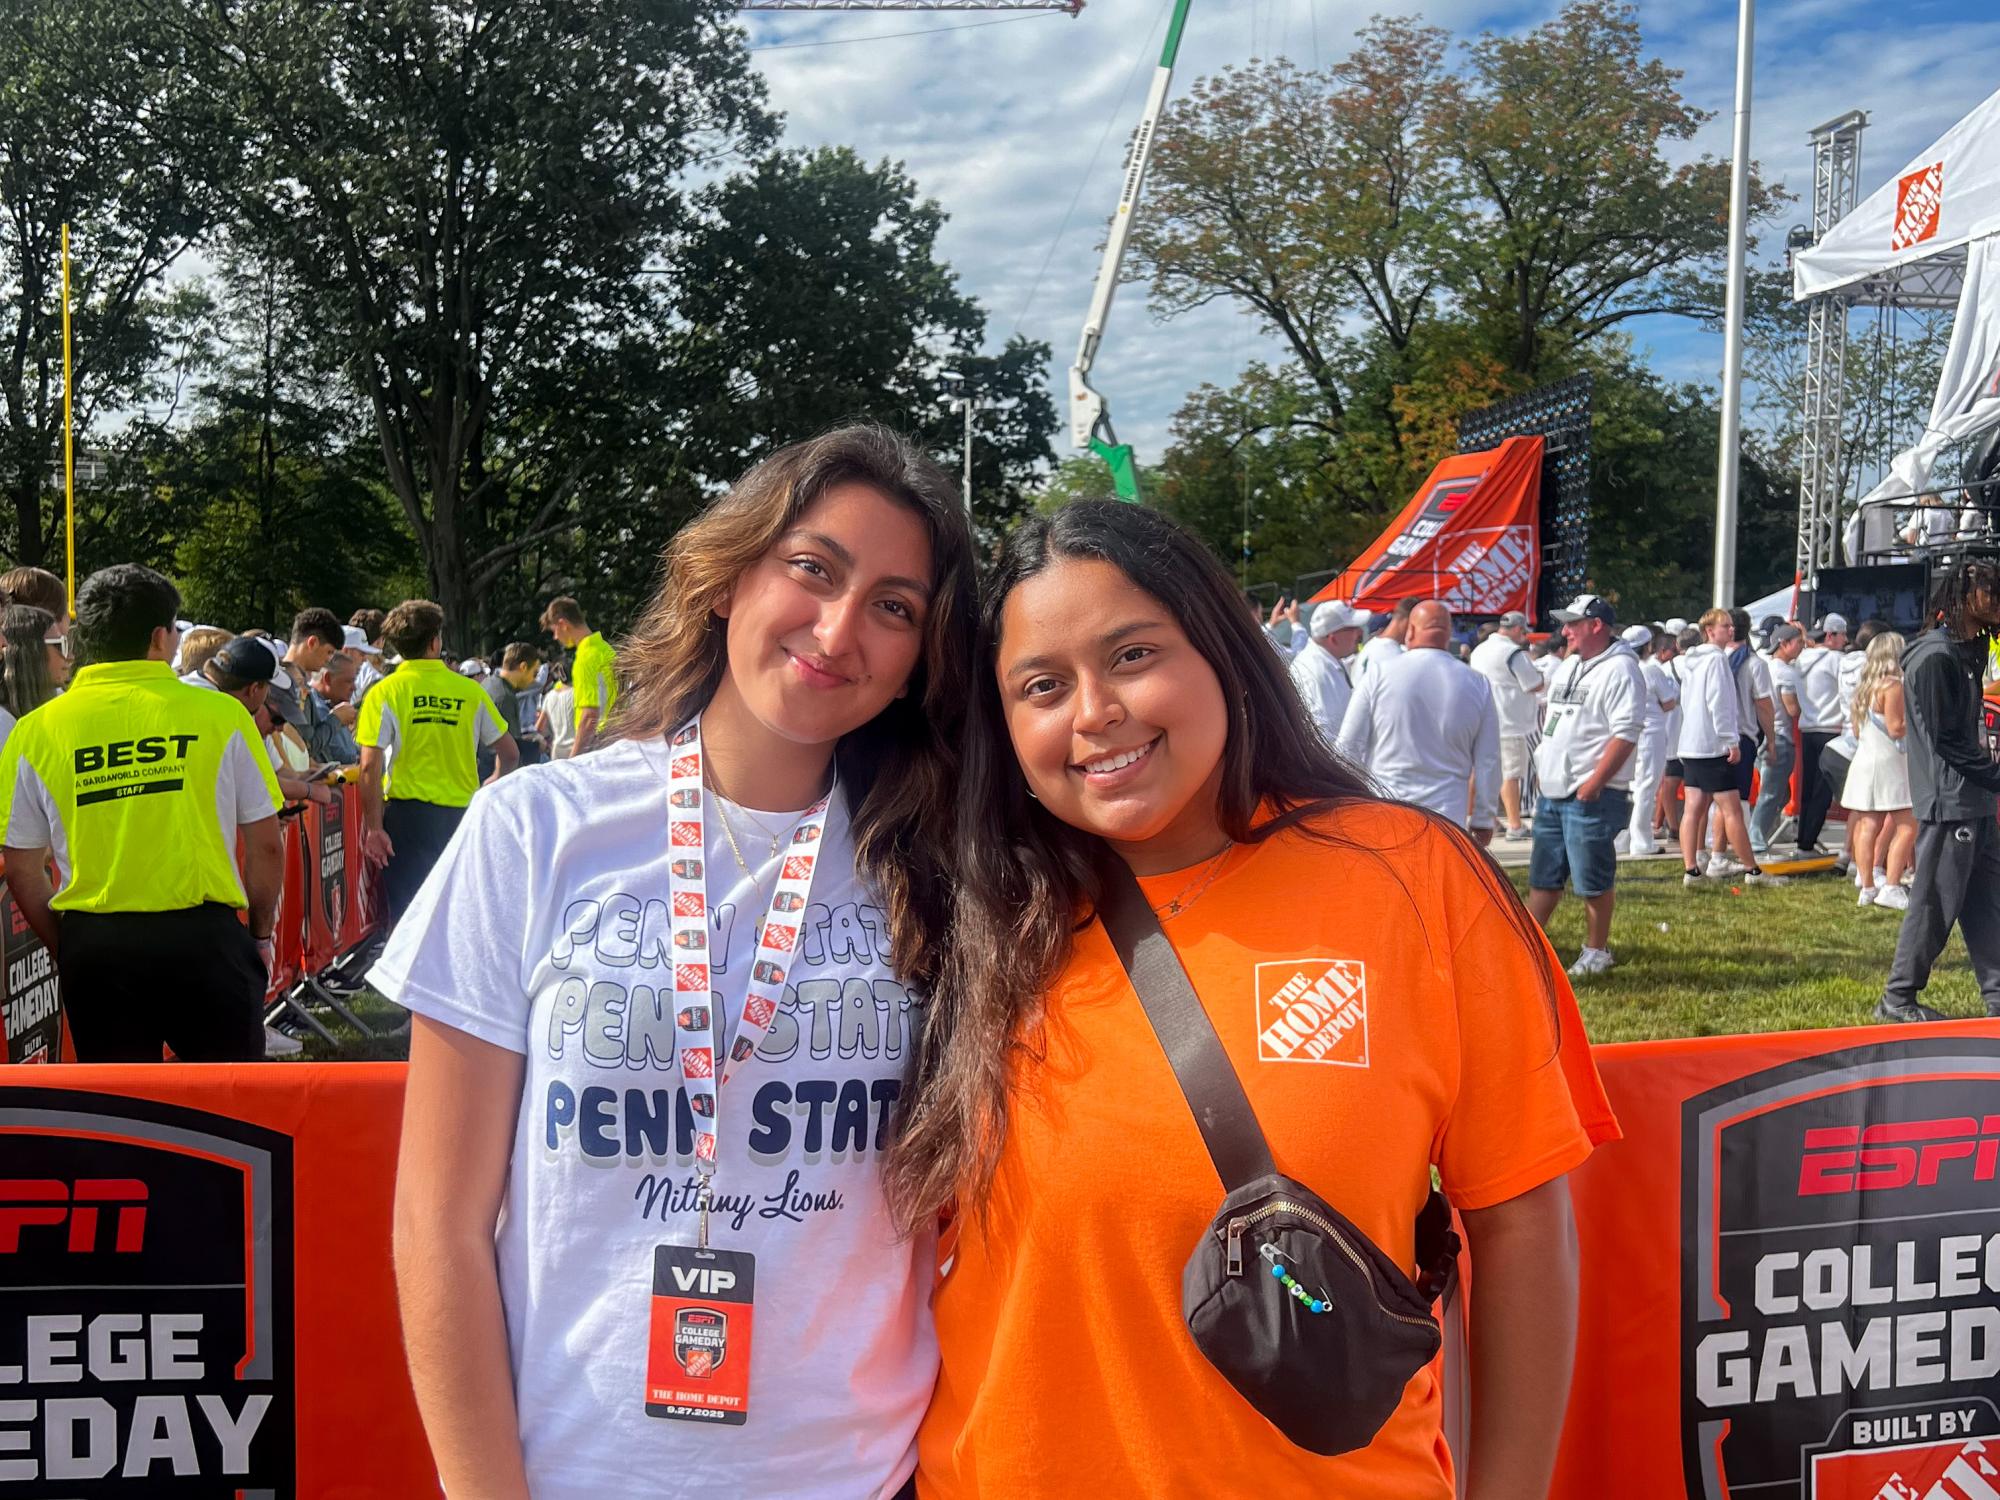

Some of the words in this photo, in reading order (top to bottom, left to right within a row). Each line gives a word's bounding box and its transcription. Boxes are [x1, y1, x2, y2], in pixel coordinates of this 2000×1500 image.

[1892, 163, 1943, 249] HOME
[1901, 179, 1920, 209] THE
[1908, 188, 1940, 245] DEPOT
[1446, 541, 1488, 572] THE
[414, 695, 466, 710] BEST
[74, 735, 199, 774] BEST
[141, 764, 185, 777] COMPANY
[116, 785, 145, 797] STAFF
[9, 946, 51, 996] COLLEGE
[1268, 971, 1312, 1010] THE
[754, 978, 923, 1063] STAT
[1260, 961, 1364, 1058] HOME
[1303, 998, 1364, 1060] DEPOT
[748, 1079, 901, 1167] STAT
[0, 1178, 149, 1253] PN
[671, 1266, 736, 1294] VIP
[682, 1326, 720, 1338] COLLEGE
[688, 1314, 715, 1325] ESPN
[675, 1335, 726, 1348] GAMEDAY
[1696, 1306, 2000, 1409] GAMED
[652, 1389, 673, 1401] THE
[676, 1391, 705, 1404] HOME
[706, 1395, 741, 1407] DEPOT
[666, 1406, 725, 1419] 9.27.2025
[1853, 1413, 1932, 1444] BUILT
[1939, 1408, 1976, 1436] BY
